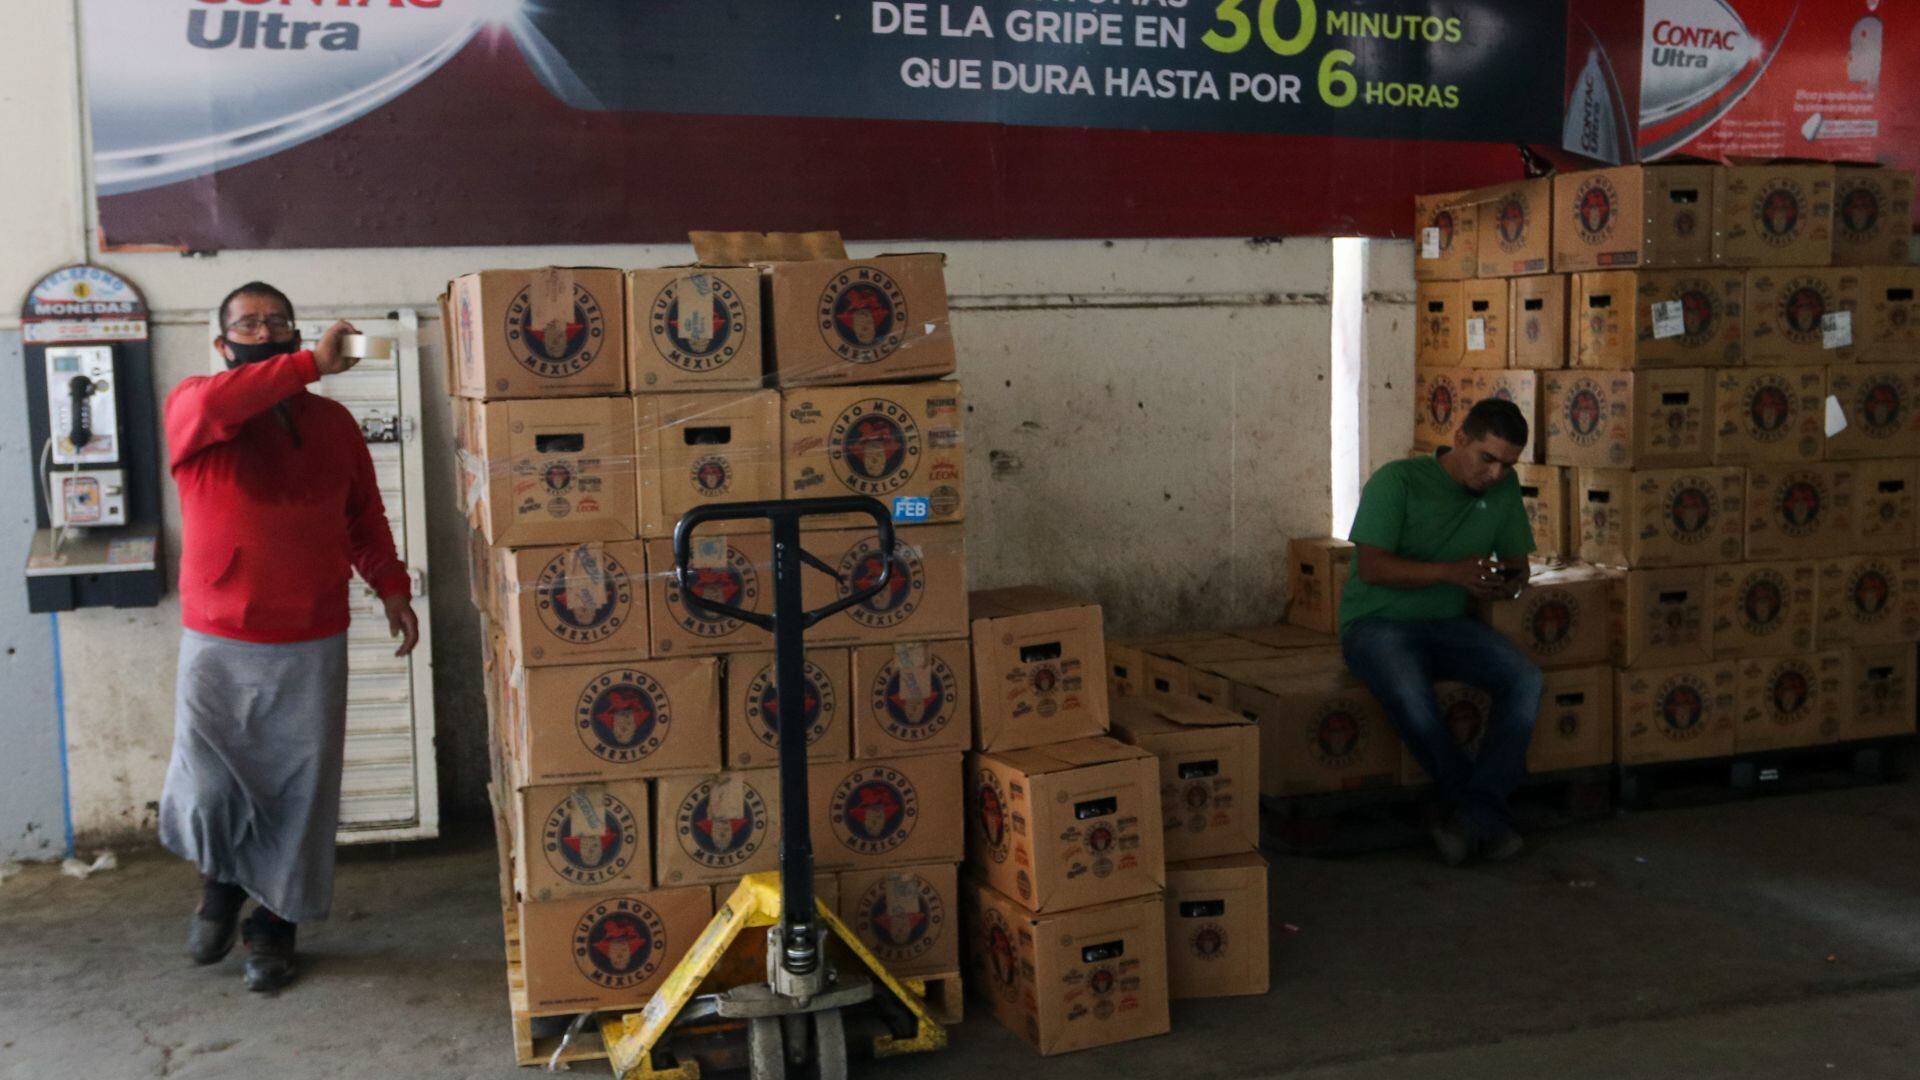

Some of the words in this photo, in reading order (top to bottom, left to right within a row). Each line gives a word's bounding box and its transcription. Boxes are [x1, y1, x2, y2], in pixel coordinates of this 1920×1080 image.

[186, 9, 361, 51] Ultra
[872, 1, 928, 35] DE
[940, 4, 994, 38] LA
[1005, 10, 1123, 46] GRIPE
[1135, 15, 1187, 49] EN
[1200, 0, 1317, 56] 30
[1326, 10, 1462, 43] MINUTOS
[1652, 20, 1738, 51] CONTAC
[1651, 47, 1709, 69] Ultra
[900, 57, 982, 89] QUE
[991, 60, 1096, 95] DURA
[1104, 67, 1220, 100] HASTA
[1229, 72, 1301, 104] POR
[1317, 49, 1358, 108] 6
[1365, 82, 1459, 109] HORAS
[34, 303, 132, 315] MONEDAS
[712, 280, 744, 333] ODELO
[822, 274, 849, 330] GRUPO
[858, 269, 906, 322] MODELO
[669, 346, 734, 370] MEXICO
[838, 335, 898, 361] MEXICO
[525, 350, 591, 376] MEXICO
[832, 405, 862, 460] GRUPO
[873, 401, 919, 456] MODELO
[846, 468, 910, 493] MEXICO
[895, 501, 927, 518] FEB
[726, 548, 756, 598] ODELO
[683, 617, 737, 635] MEXIC
[853, 602, 914, 626] MEXICO
[555, 617, 620, 641] MEXICO
[578, 676, 611, 729] GRUPO
[621, 671, 669, 724] MODELO
[887, 714, 947, 740] MEXICO
[594, 736, 659, 761] MEXICO
[832, 773, 863, 824] GRUPO
[872, 768, 916, 818] MODELO
[603, 796, 635, 845] ODELO
[679, 784, 711, 836] GRUPO
[693, 842, 755, 866] MEXICO
[846, 829, 907, 853] MEXICO
[562, 857, 626, 882] MEXICO
[575, 905, 607, 957] GRUPO
[617, 900, 664, 950] MODELO
[590, 962, 655, 986] MEXICO
